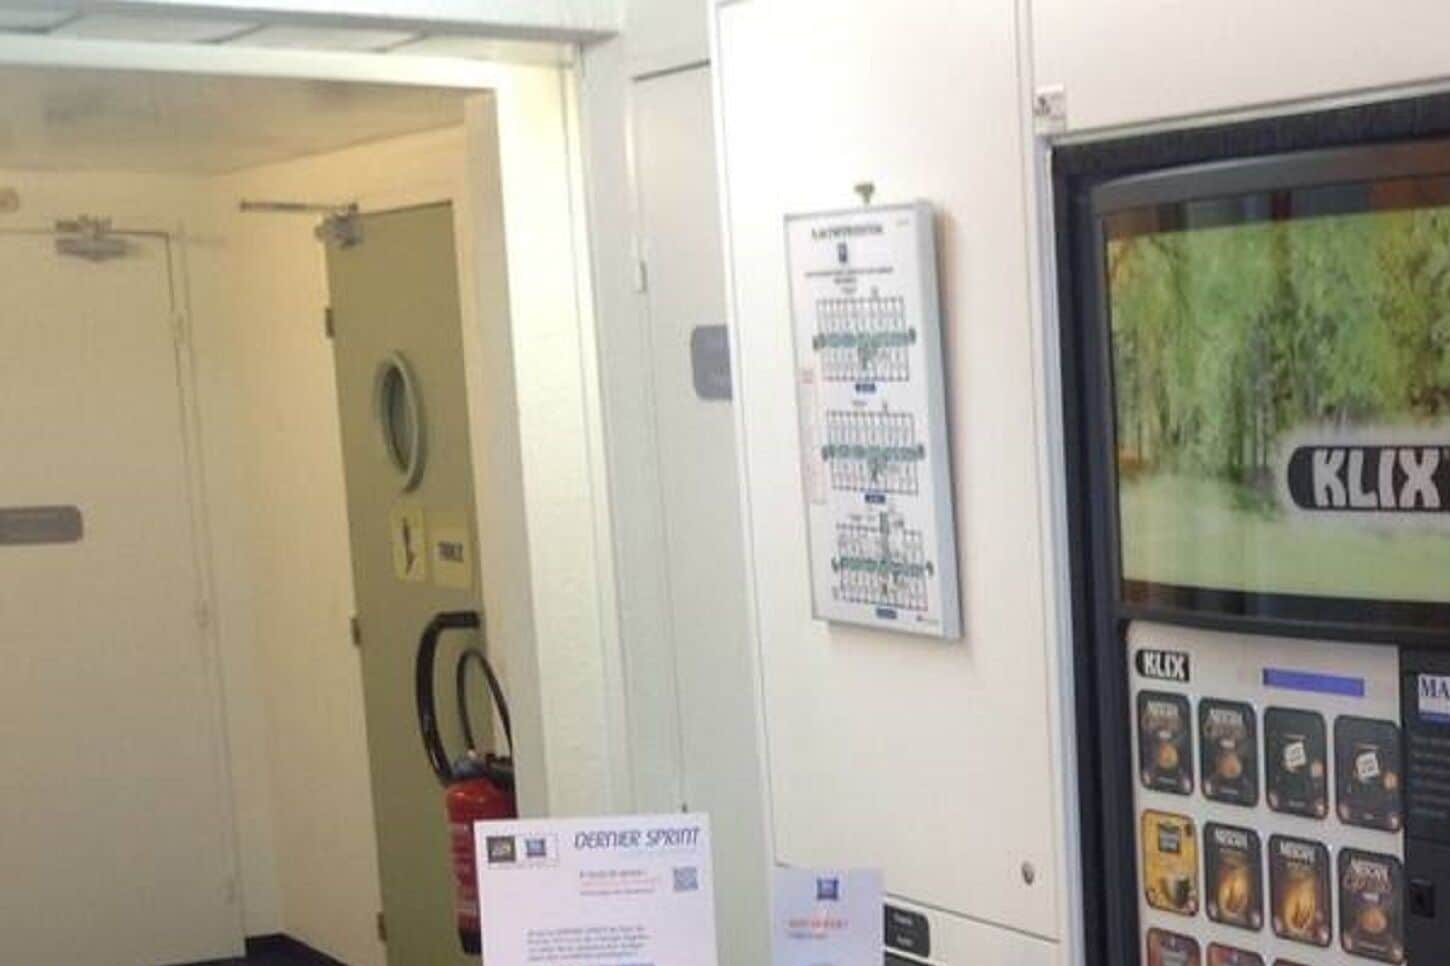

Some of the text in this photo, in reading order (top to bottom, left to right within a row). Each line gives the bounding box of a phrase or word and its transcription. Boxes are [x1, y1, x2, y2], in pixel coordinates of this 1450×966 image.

[1313, 449, 1441, 508] KLIX
[1143, 651, 1186, 680] KLIX
[574, 825, 700, 850] DERNIER SPRINT
